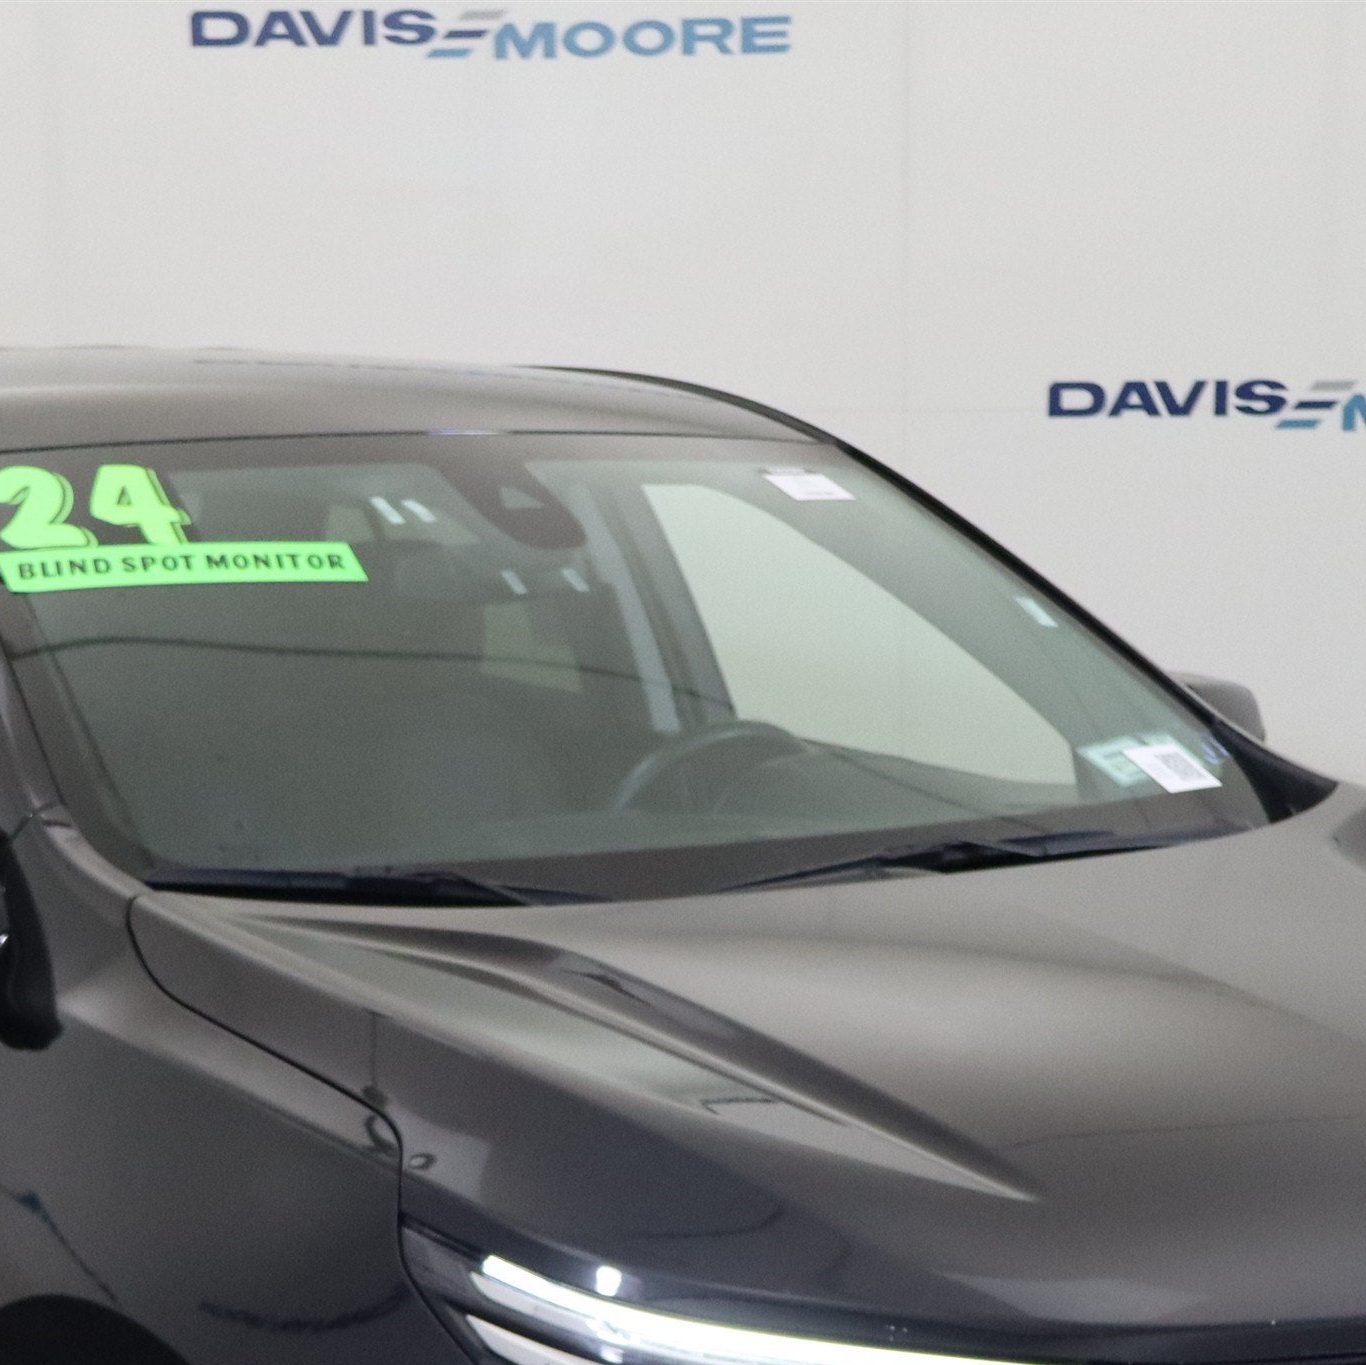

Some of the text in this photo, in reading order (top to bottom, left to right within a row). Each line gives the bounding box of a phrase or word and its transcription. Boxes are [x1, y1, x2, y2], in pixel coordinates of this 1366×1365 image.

[190, 9, 792, 60] DAVIS MOORE
[1047, 379, 1288, 417] DAVIS
[18, 553, 347, 580] BLIND SPOT MONITOR
